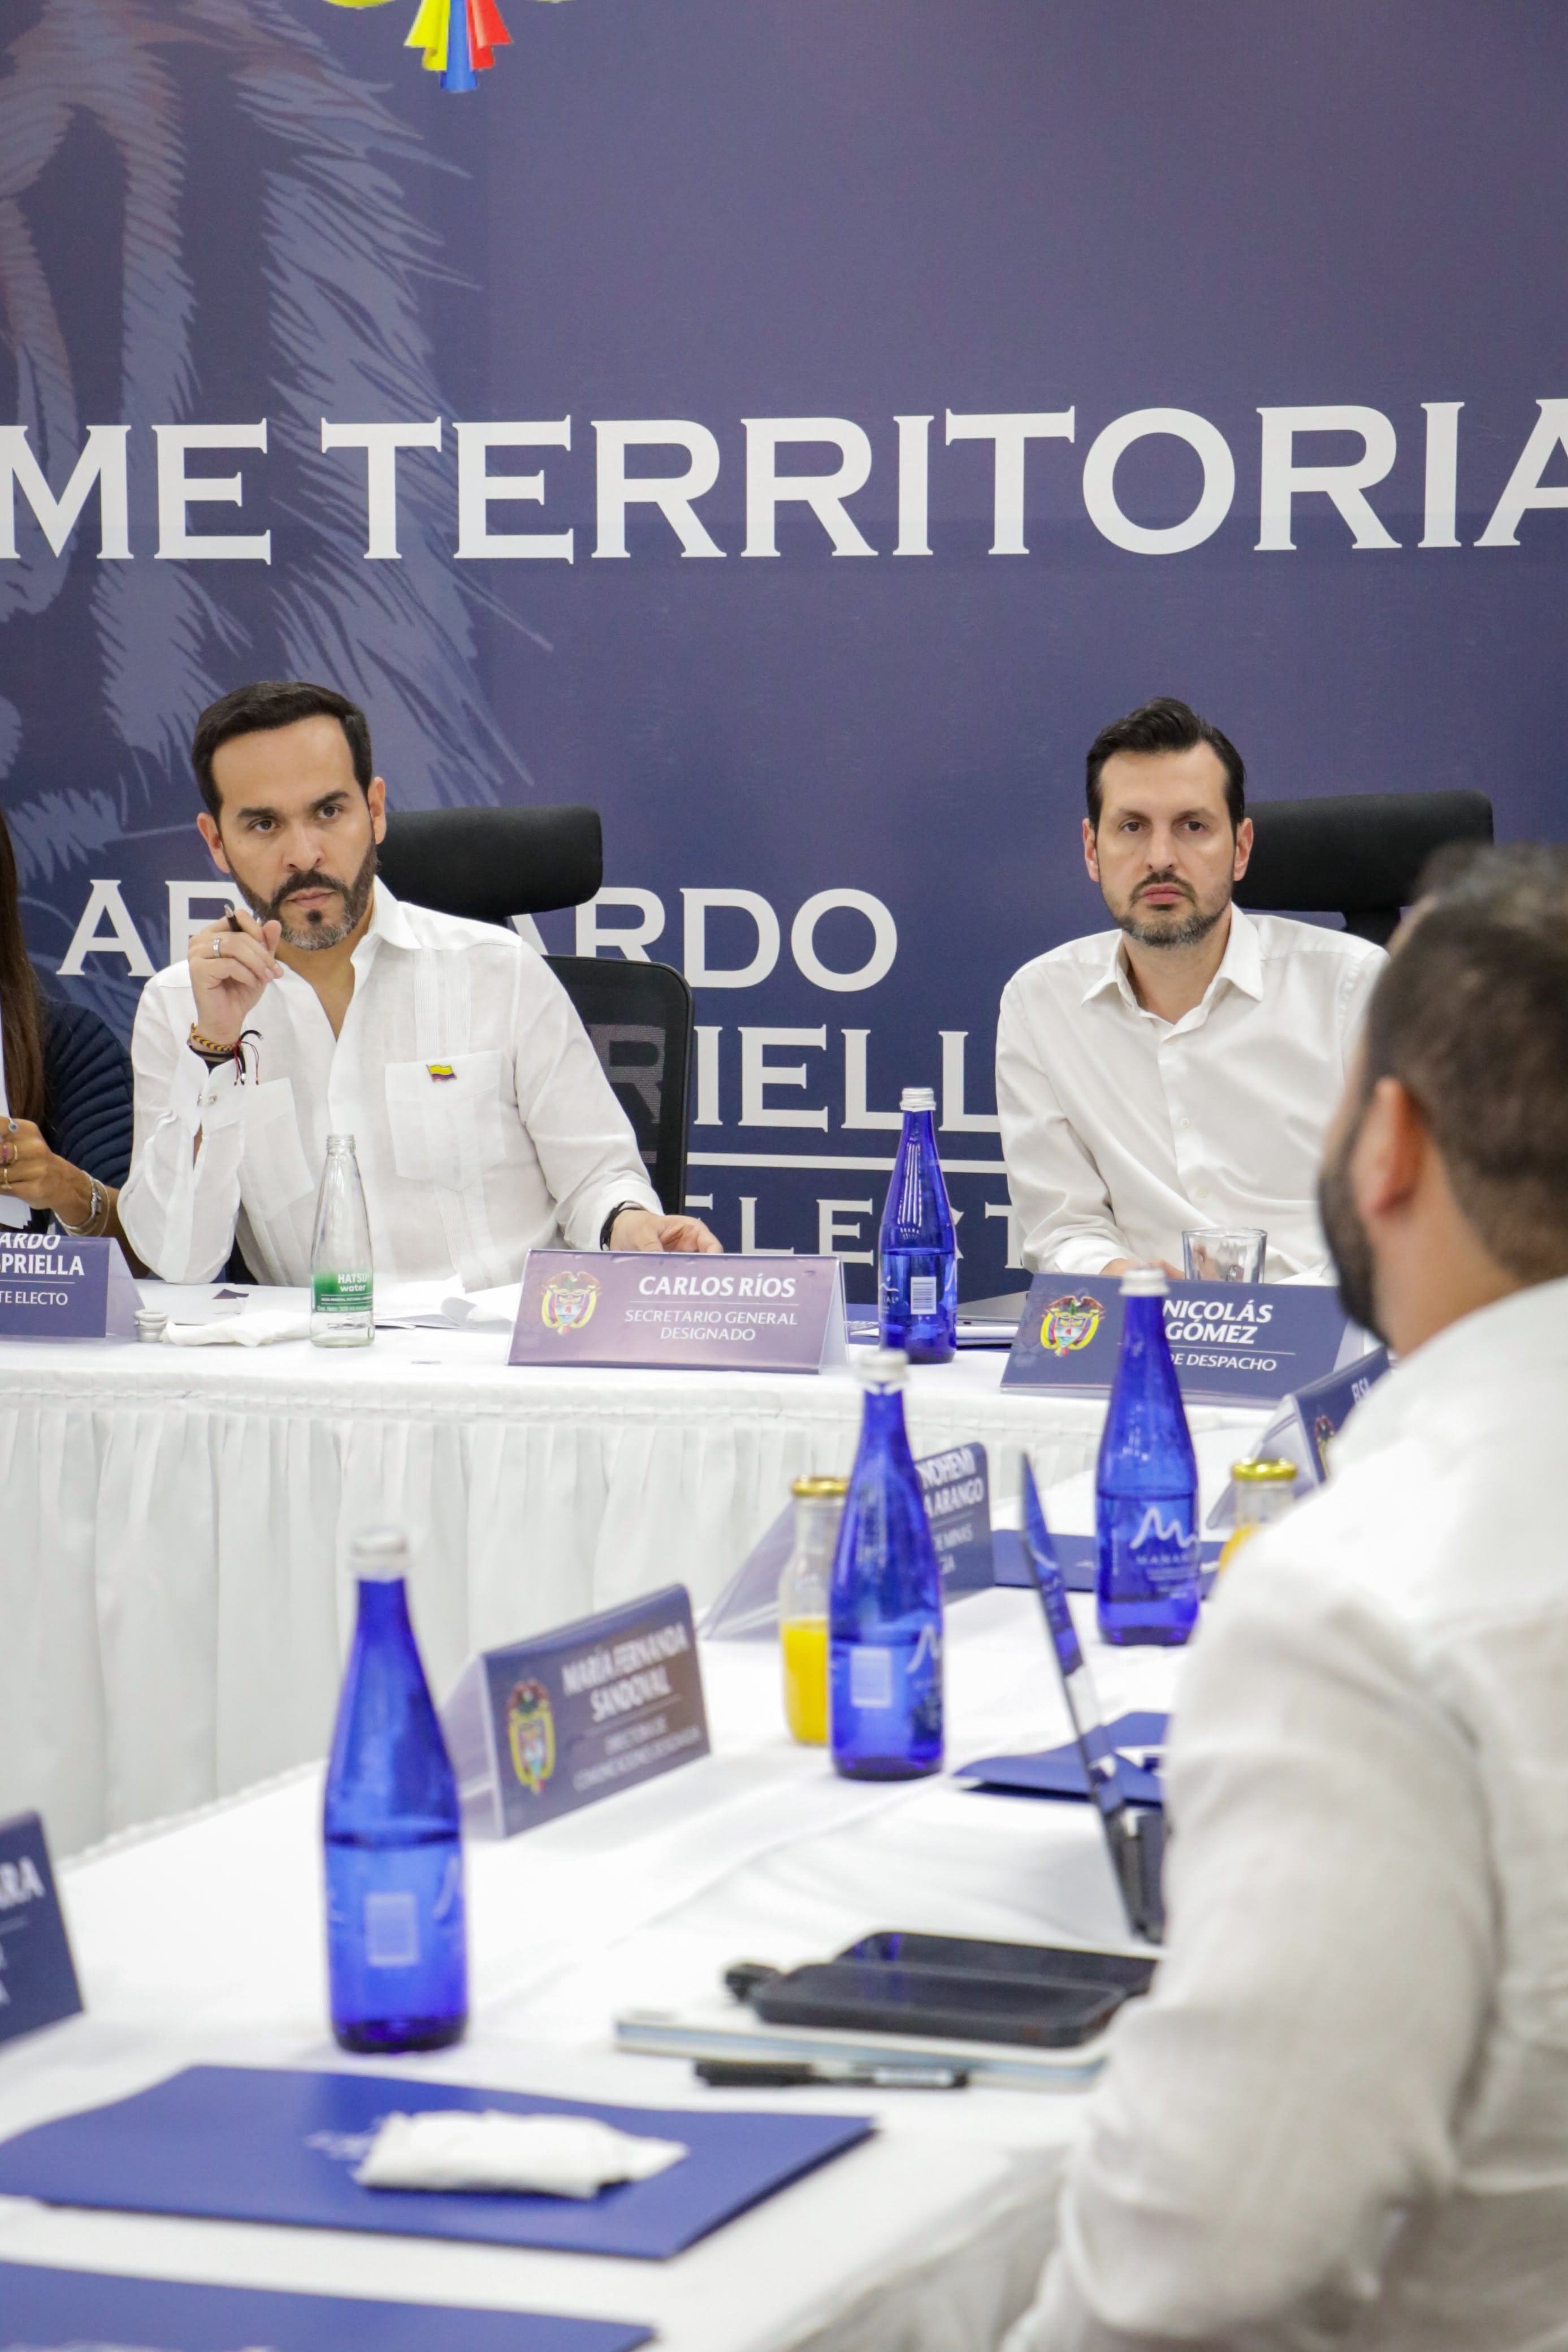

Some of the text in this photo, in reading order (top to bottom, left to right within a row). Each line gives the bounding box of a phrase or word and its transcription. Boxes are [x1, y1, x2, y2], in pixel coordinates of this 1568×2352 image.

[0, 397, 1568, 565] ME TERRITORIA
[0, 1252, 85, 1276] PRIELLA
[337, 1273, 367, 1284] HATSU
[339, 1284, 366, 1292] water
[639, 1273, 796, 1298] CARLOS RÍOS
[15, 1291, 68, 1305] ELECTO
[625, 1309, 798, 1325] SECRETARIO GENERAL
[1162, 1299, 1274, 1324] NICOLÁS
[660, 1326, 756, 1341] DESIGNADO
[1165, 1318, 1259, 1345] GÓMEZ
[1169, 1353, 1277, 1372] E DESPACHO
